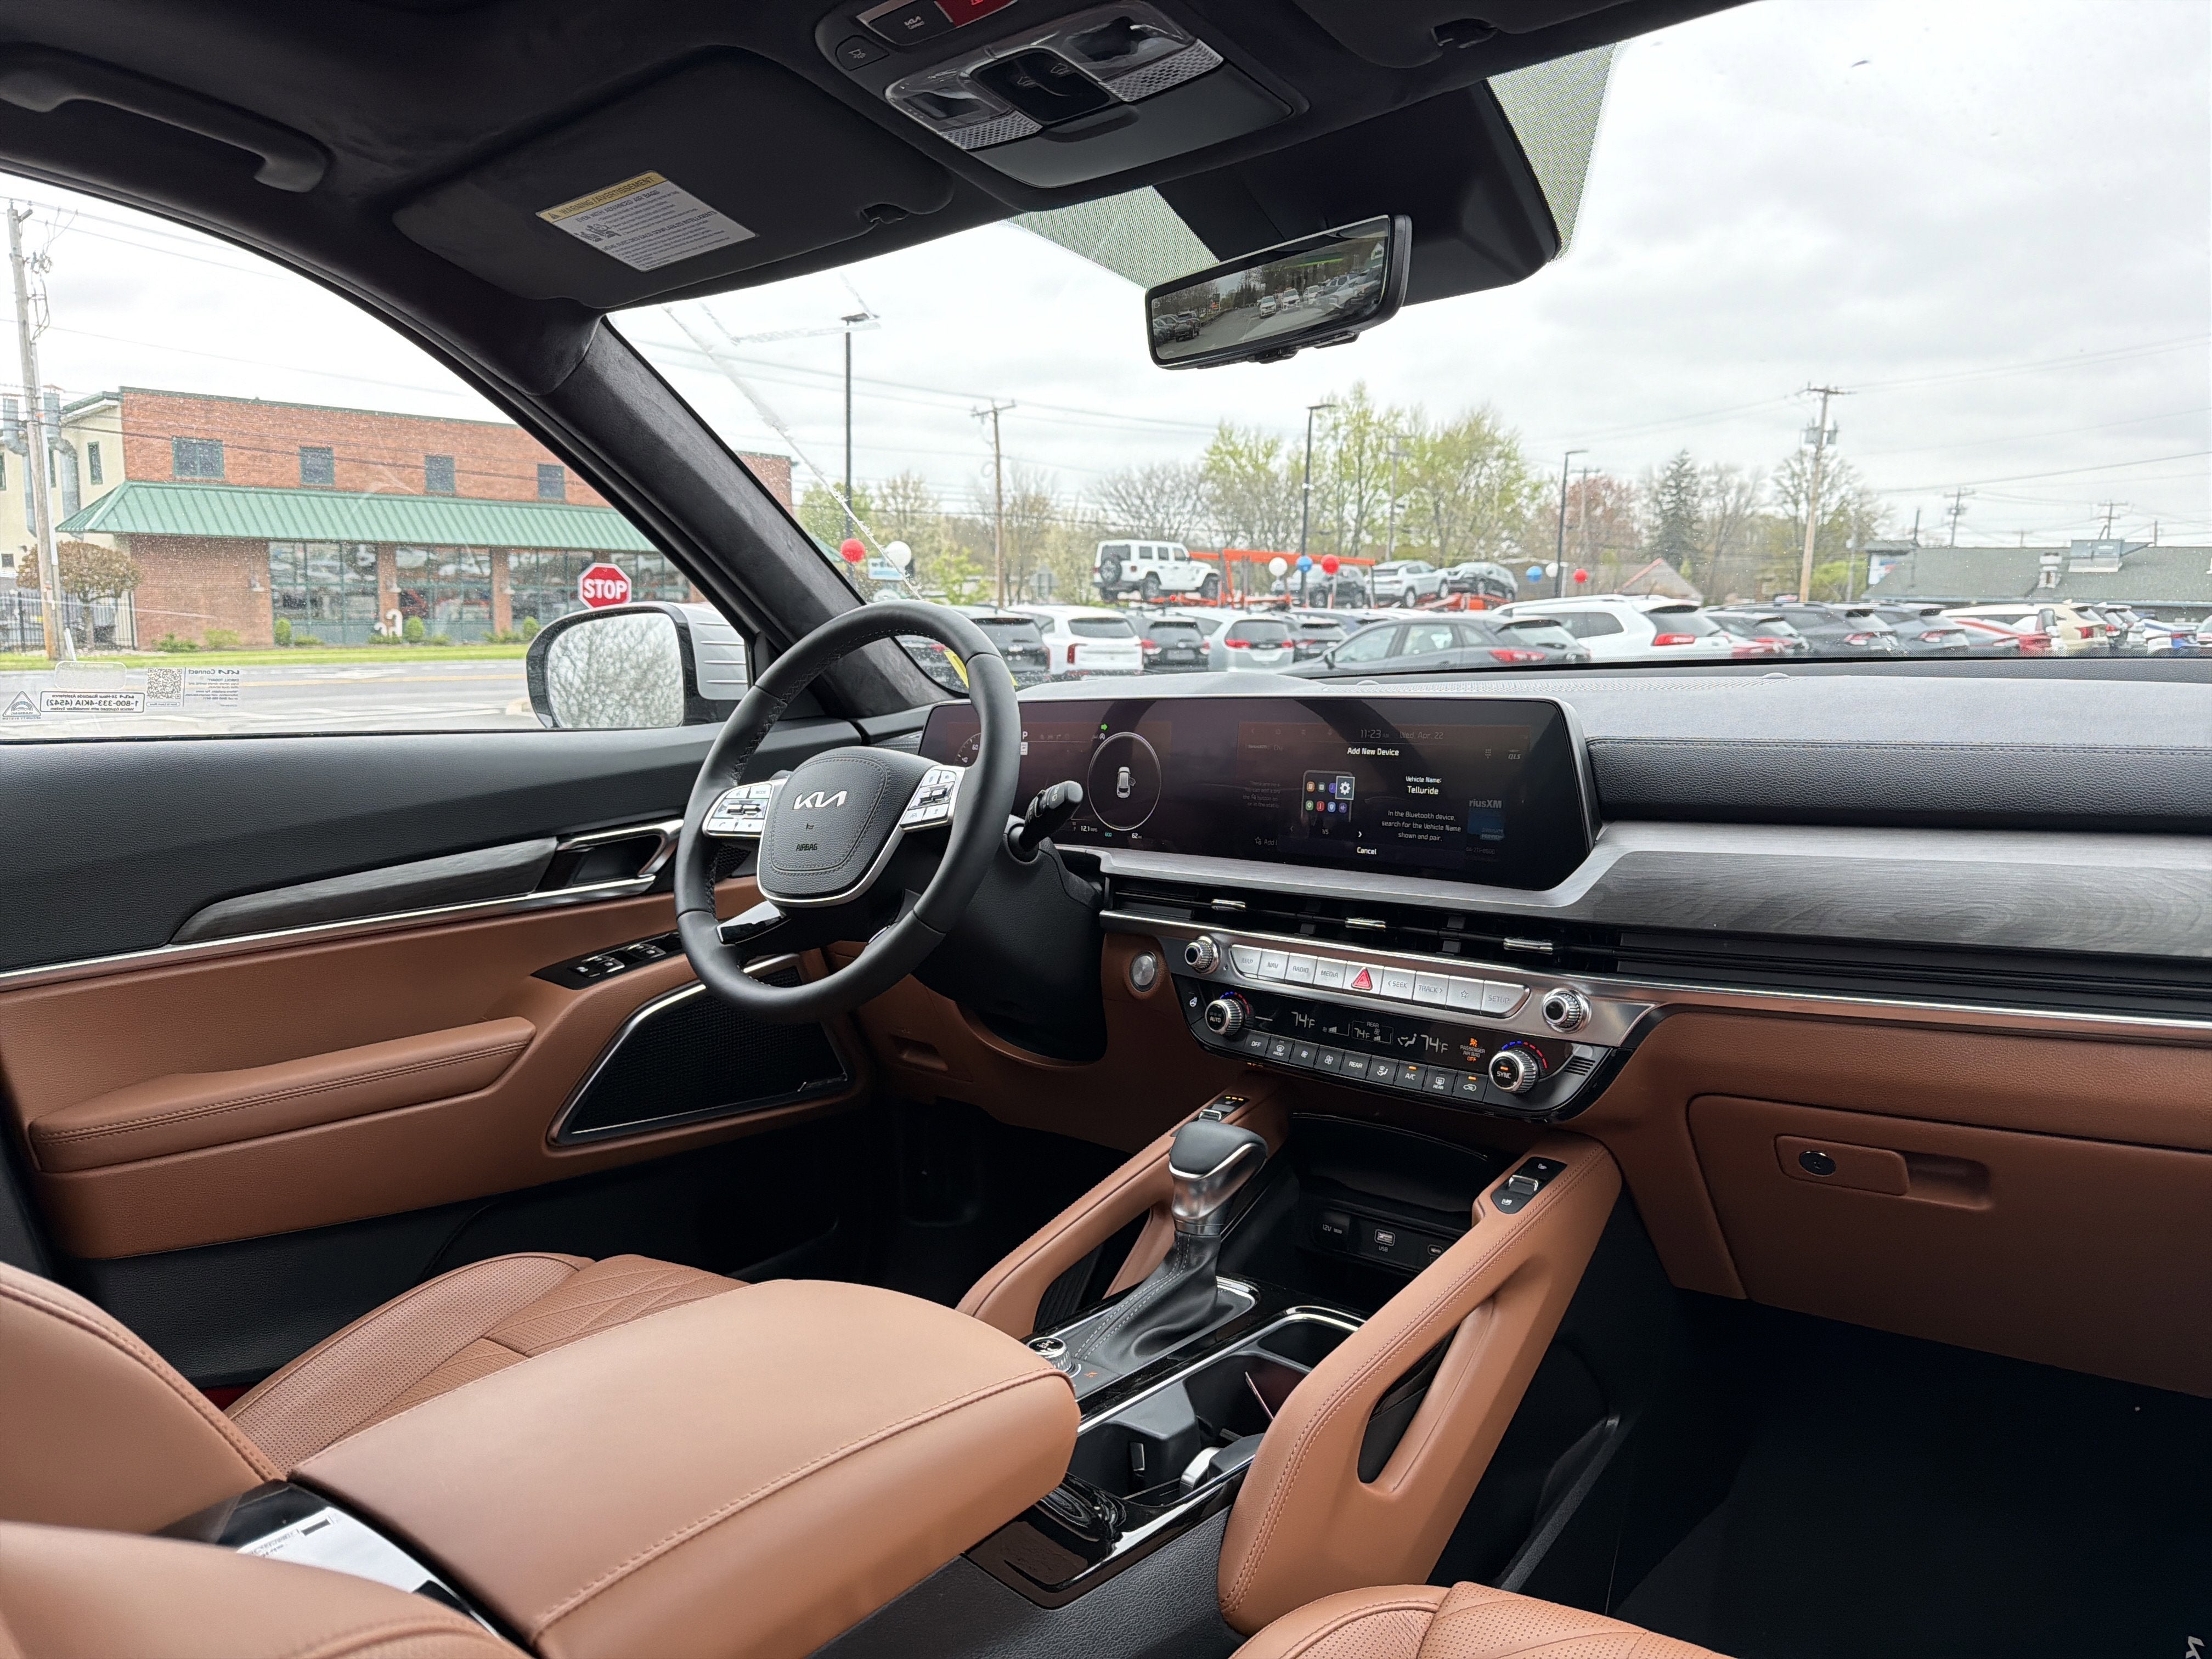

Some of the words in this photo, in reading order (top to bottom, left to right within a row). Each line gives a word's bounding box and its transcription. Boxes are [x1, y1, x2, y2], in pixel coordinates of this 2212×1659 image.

[605, 200, 634, 214] ADVANCED
[642, 190, 661, 202] BAGS
[560, 199, 594, 215] WARNING
[582, 578, 628, 600] STOP
[1022, 731, 1028, 740] P
[1361, 729, 1381, 739] 11:23
[1434, 732, 1444, 741] 22
[1347, 747, 1361, 755] Add
[1376, 748, 1400, 756] Device
[1407, 785, 1439, 795] Telluride
[1469, 799, 1502, 809] riusXM
[1405, 811, 1435, 819] Bluetooth
[1357, 847, 1377, 855] Cancel
[1321, 970, 1339, 978] MEDIA
[1419, 984, 1438, 994] TRACK
[1488, 995, 1510, 1004] SETUP
[1460, 1045, 1486, 1053] PASSENGER
[1348, 1060, 1363, 1069] REAR
[1497, 1070, 1511, 1080] SYNC
